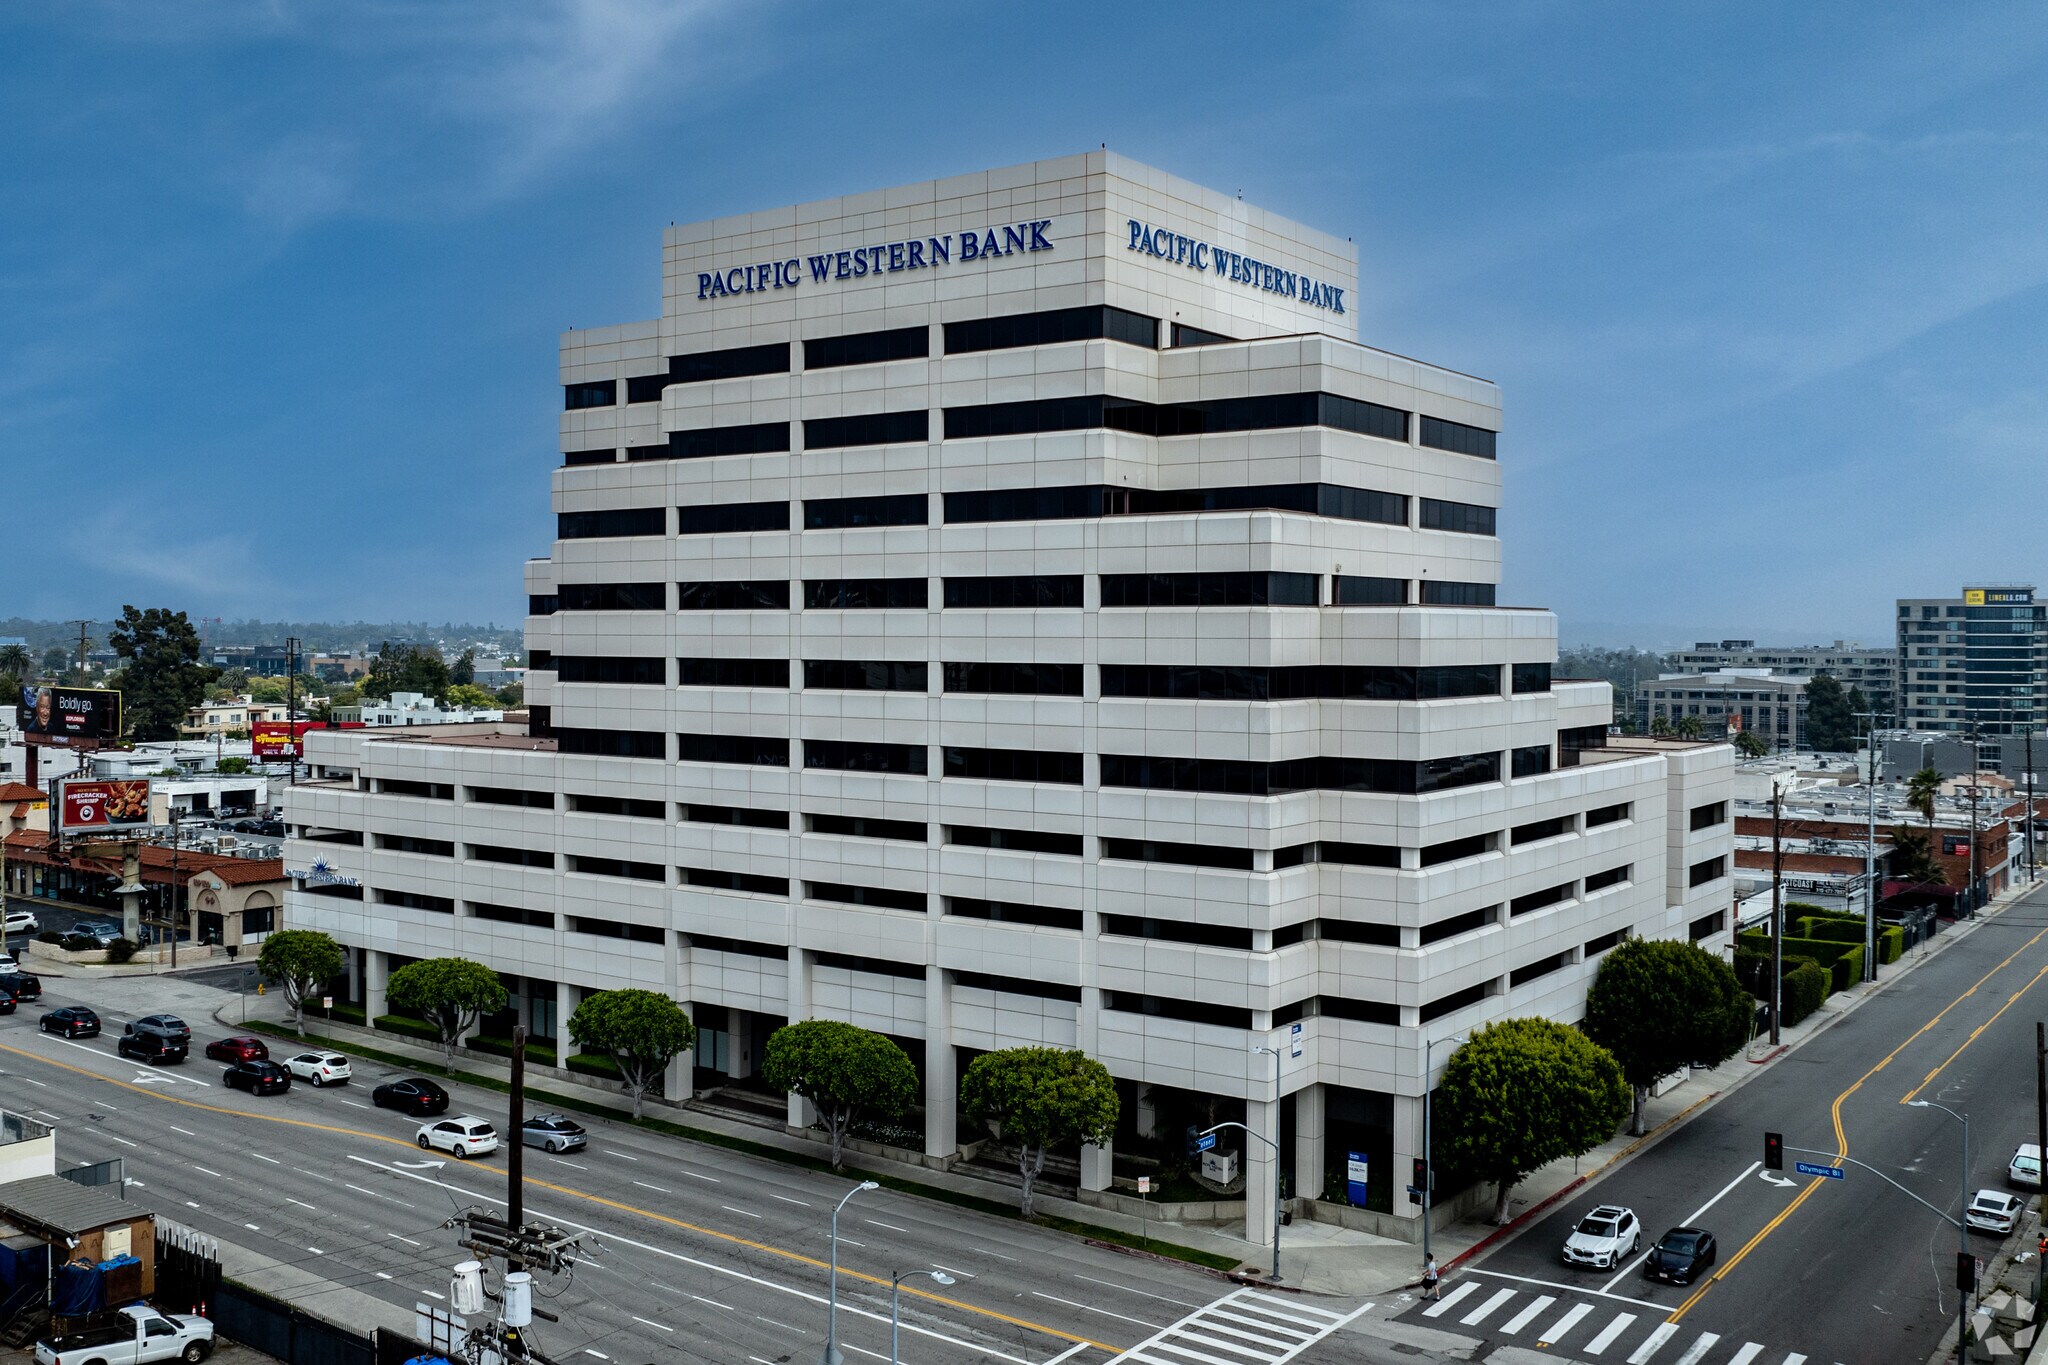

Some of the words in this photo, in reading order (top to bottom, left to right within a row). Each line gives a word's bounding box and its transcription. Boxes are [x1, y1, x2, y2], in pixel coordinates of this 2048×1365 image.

[698, 258, 801, 300] PACIFIC
[808, 235, 953, 284] WESTERN
[959, 220, 1054, 262] BANK
[1127, 219, 1209, 271] PACIFIC
[1211, 246, 1297, 300] WESTERN
[1299, 275, 1346, 314] BANK
[59, 696, 81, 712] Boldly
[81, 700, 93, 713] go.
[67, 792, 108, 800] FIRECRACKER
[1780, 880, 1814, 889] STCOAST
[1799, 1164, 1830, 1176] Olympic
[1832, 1169, 1841, 1177] Bl
